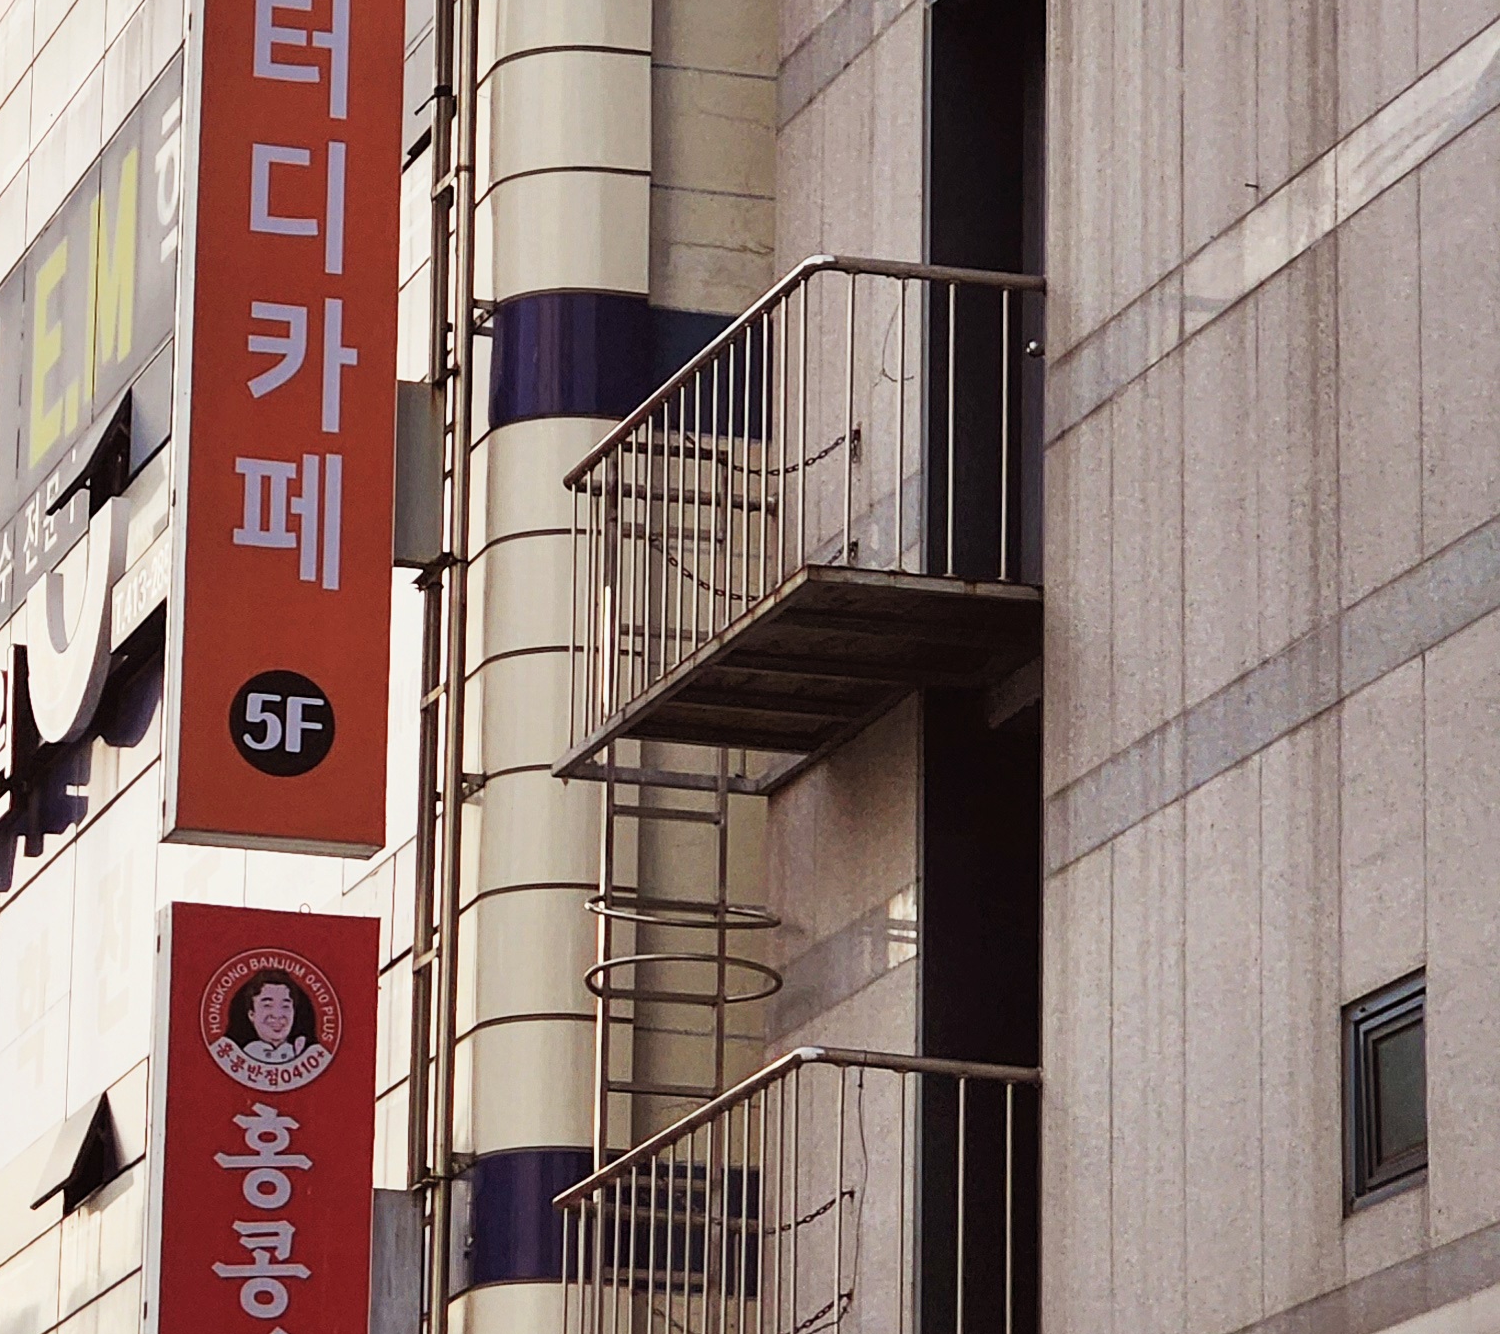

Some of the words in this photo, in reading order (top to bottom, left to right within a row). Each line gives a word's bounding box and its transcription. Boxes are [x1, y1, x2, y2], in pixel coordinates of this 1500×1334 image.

[242, 694, 325, 753] 5F
[208, 963, 248, 1034] HONGKONG
[249, 956, 306, 977] BANJUM
[321, 1005, 336, 1042] PLUS
